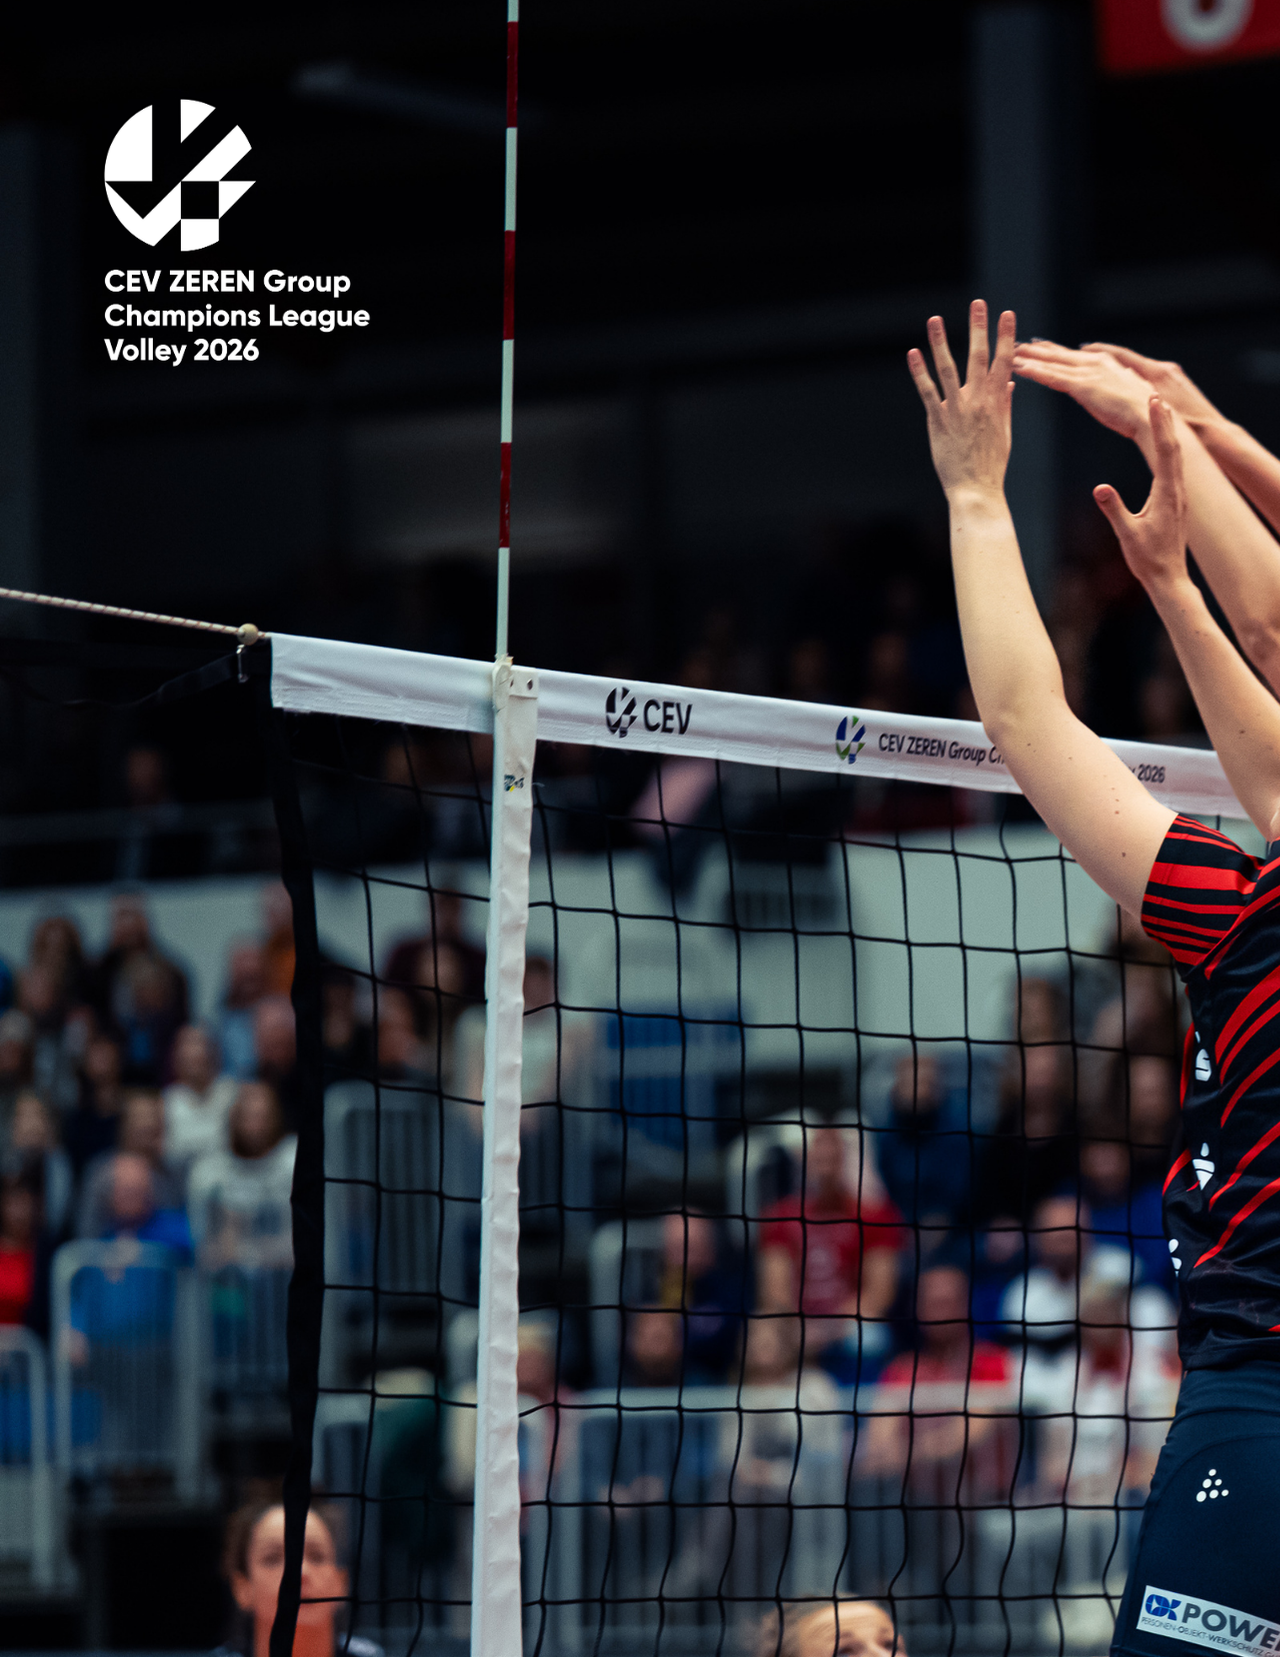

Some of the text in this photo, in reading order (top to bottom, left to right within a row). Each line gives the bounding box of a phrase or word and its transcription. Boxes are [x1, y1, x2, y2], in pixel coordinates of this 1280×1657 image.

[643, 699, 693, 735] CEV
[879, 732, 905, 753] CEV
[906, 736, 946, 758] ZEREN
[949, 741, 986, 765] Group
[1137, 763, 1166, 783] 2026
